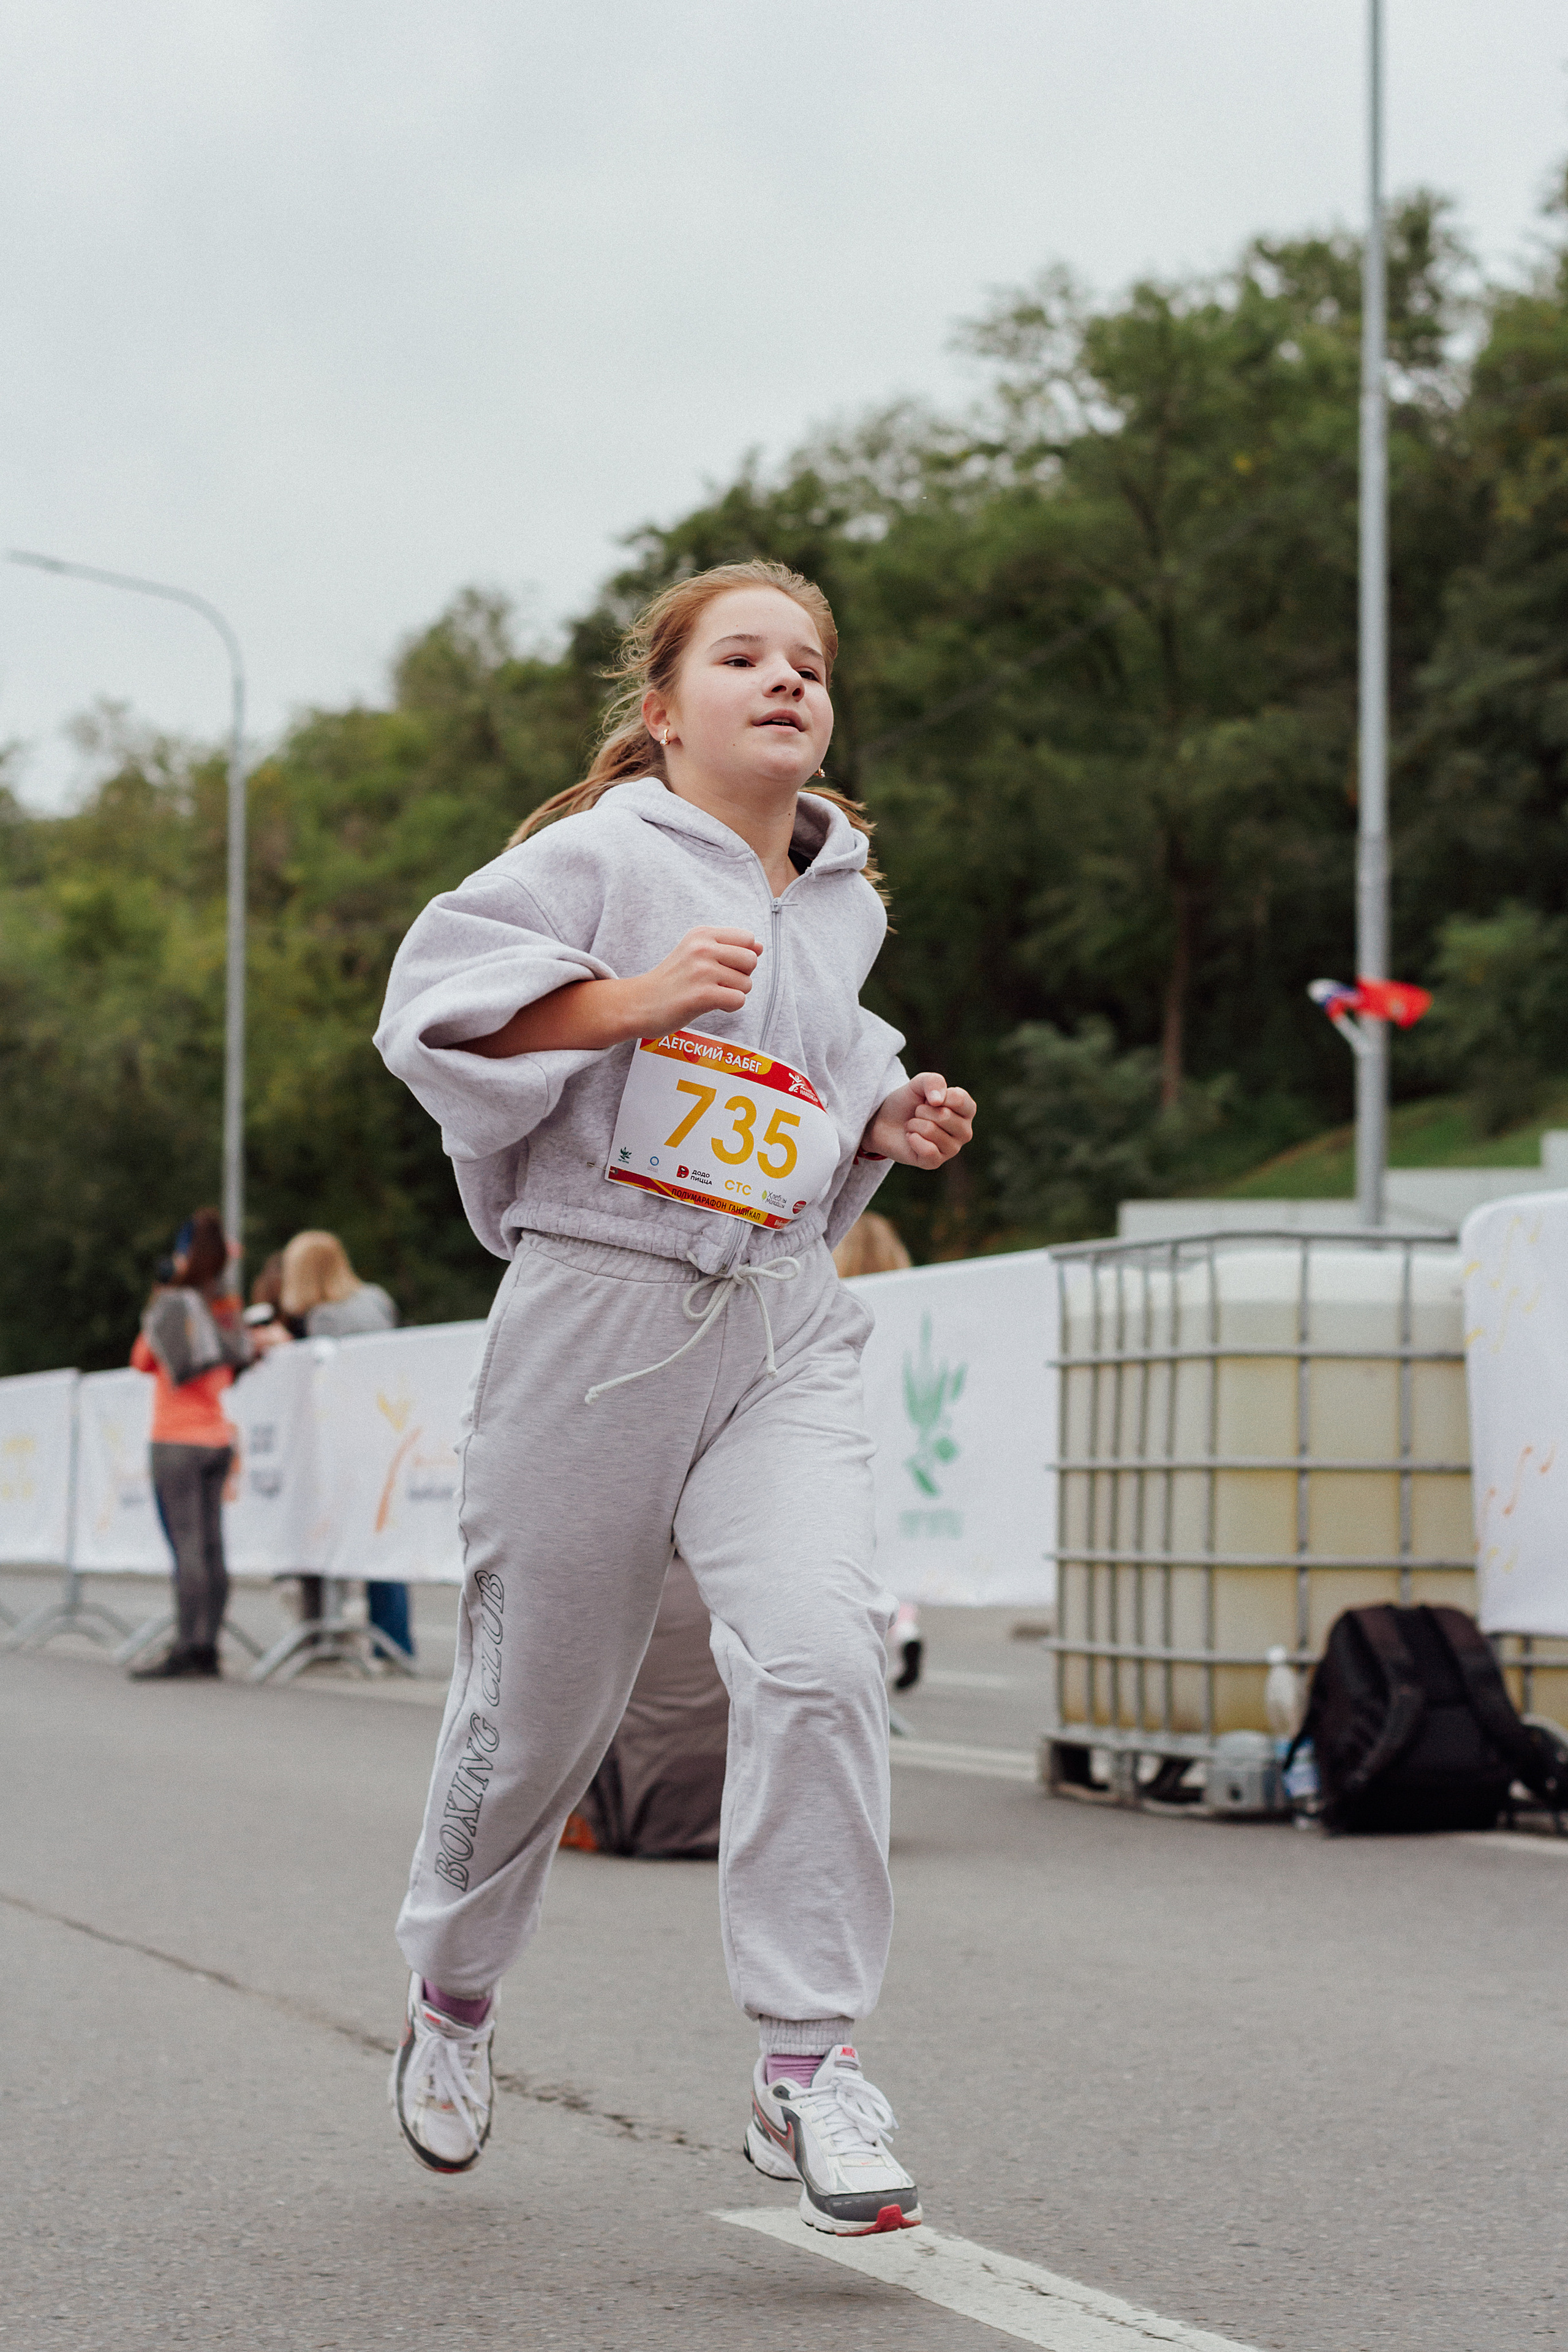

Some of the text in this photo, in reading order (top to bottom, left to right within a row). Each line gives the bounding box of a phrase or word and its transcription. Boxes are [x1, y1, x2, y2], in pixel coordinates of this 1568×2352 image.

[658, 1035, 762, 1073] ДЕТСКИЙ ЗАБЕГ
[663, 1079, 801, 1179] 735
[690, 1175, 712, 1185] ПИЦЦА
[692, 1169, 710, 1178] ДОДО
[724, 1179, 752, 1196] СТС
[671, 1188, 761, 1221] ПОЛУМАРАФОН ГАНДИКАП
[435, 1569, 505, 1893] BOXING CLUB
